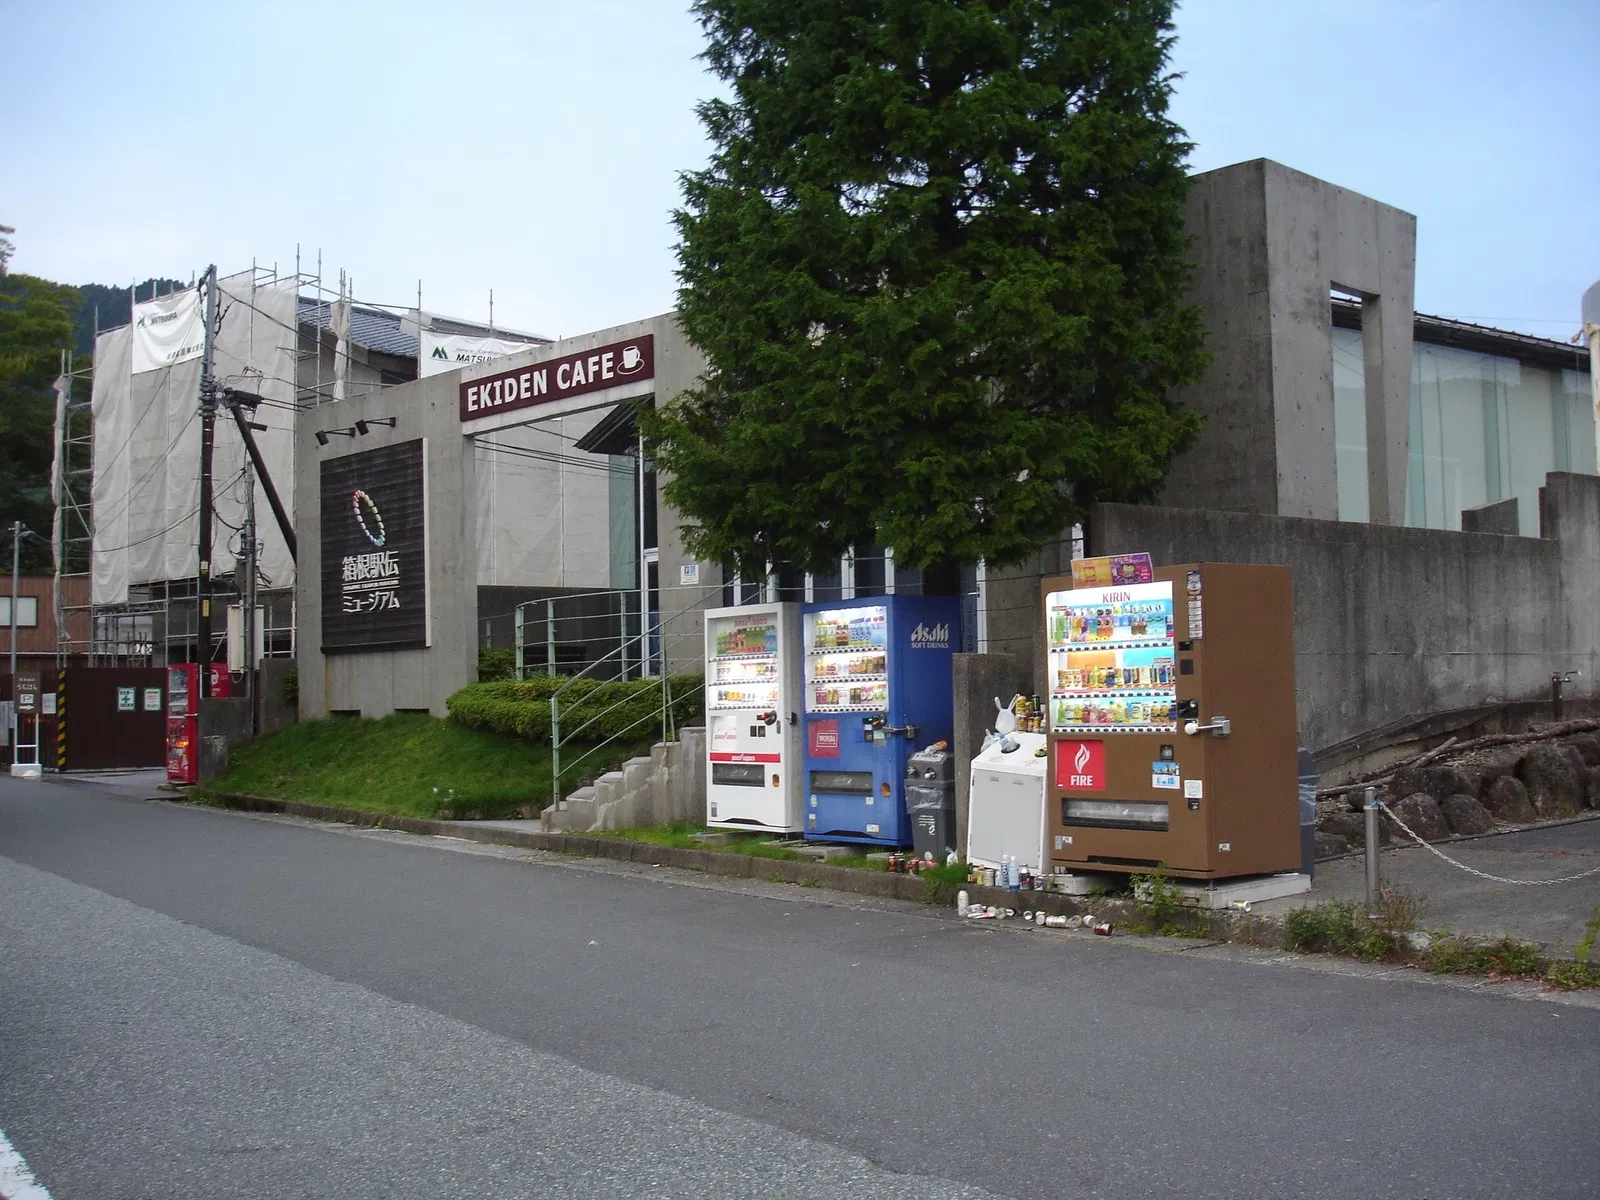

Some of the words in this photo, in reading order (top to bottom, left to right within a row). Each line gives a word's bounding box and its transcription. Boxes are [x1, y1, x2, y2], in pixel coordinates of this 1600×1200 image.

[467, 369, 547, 412] EKIDEN
[556, 351, 614, 390] CAFE
[342, 550, 399, 581] 箱根駅伝
[342, 591, 400, 612] ミュージアム
[1102, 591, 1131, 604] KIRIN
[911, 622, 949, 642] Asahi
[1070, 774, 1093, 786] FIRE
